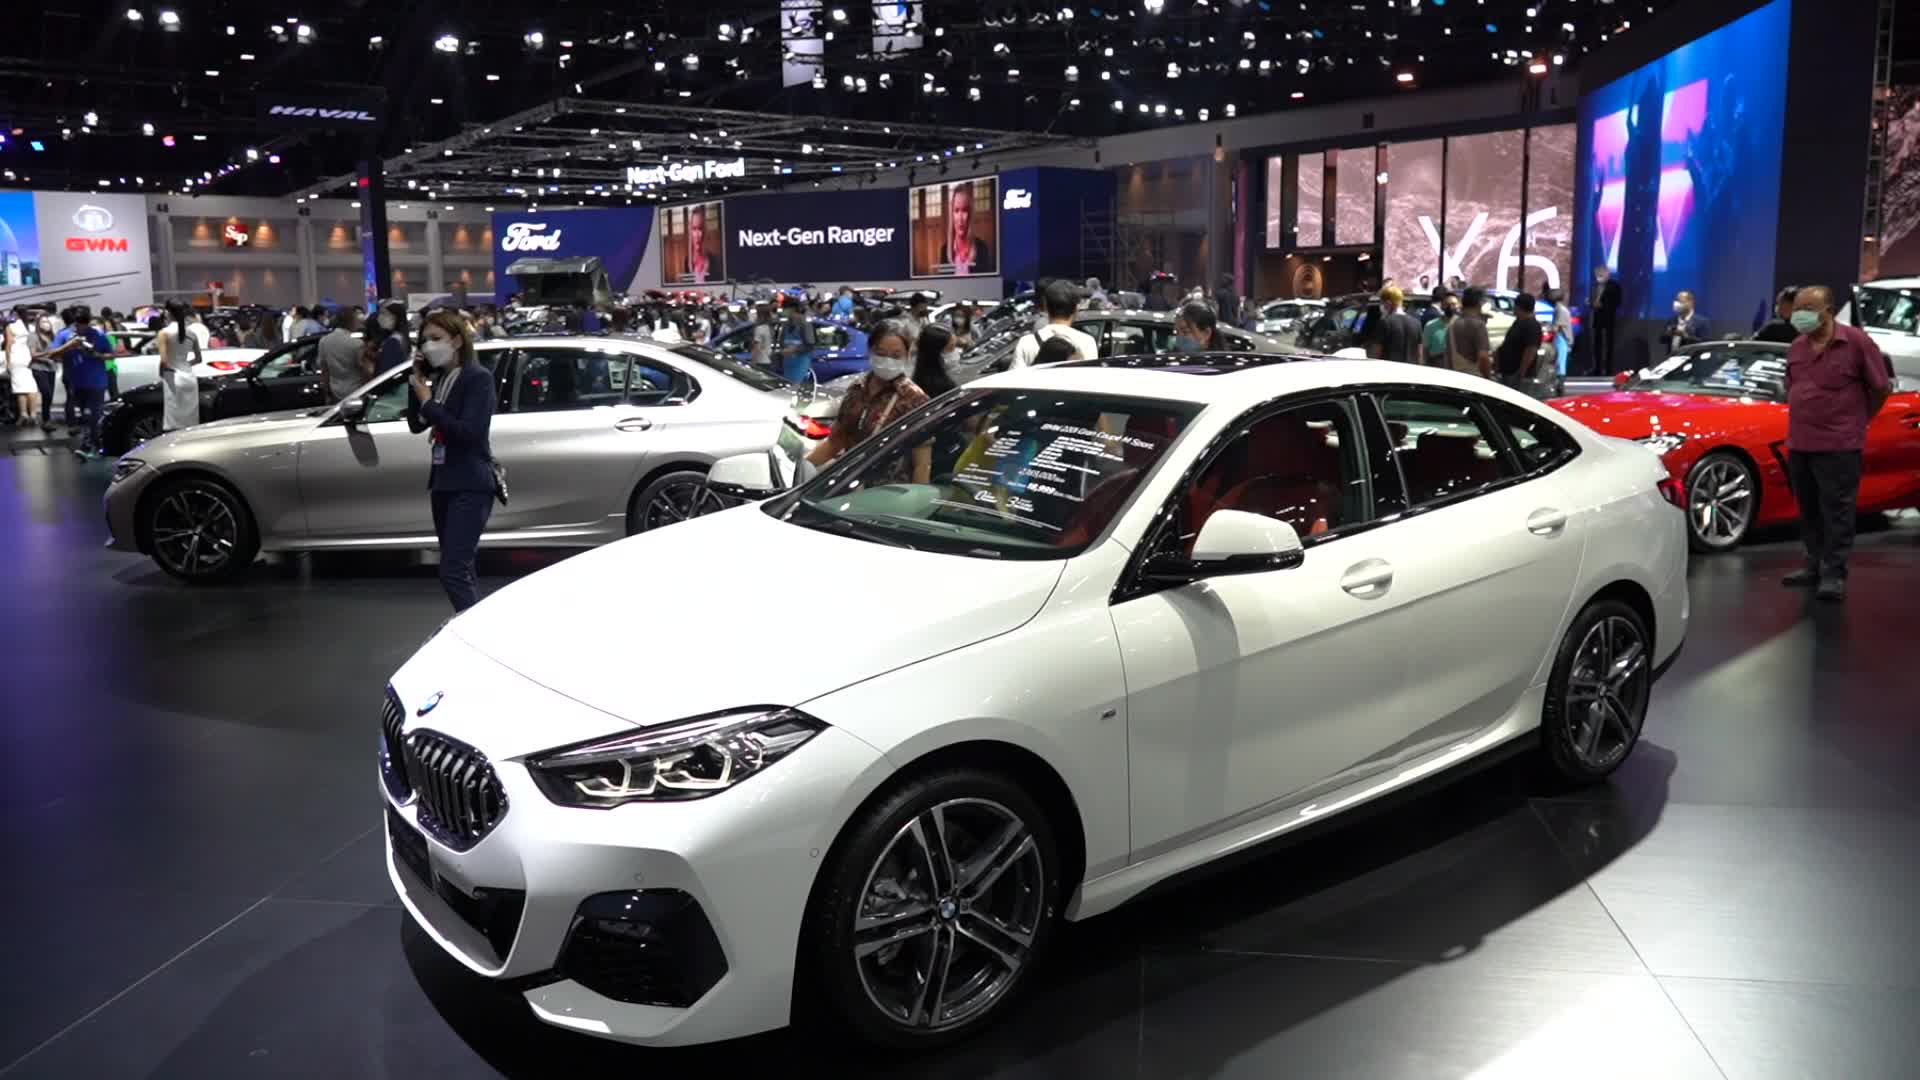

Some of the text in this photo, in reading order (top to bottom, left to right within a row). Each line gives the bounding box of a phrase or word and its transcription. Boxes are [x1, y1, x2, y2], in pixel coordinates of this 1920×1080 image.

[269, 106, 376, 120] HAVAL
[627, 157, 745, 184] Next-Gen Ford
[1003, 188, 1032, 210] Ford
[65, 237, 129, 252] GWM
[502, 222, 561, 251] Ford
[738, 225, 895, 247] Next-Gen Ranger
